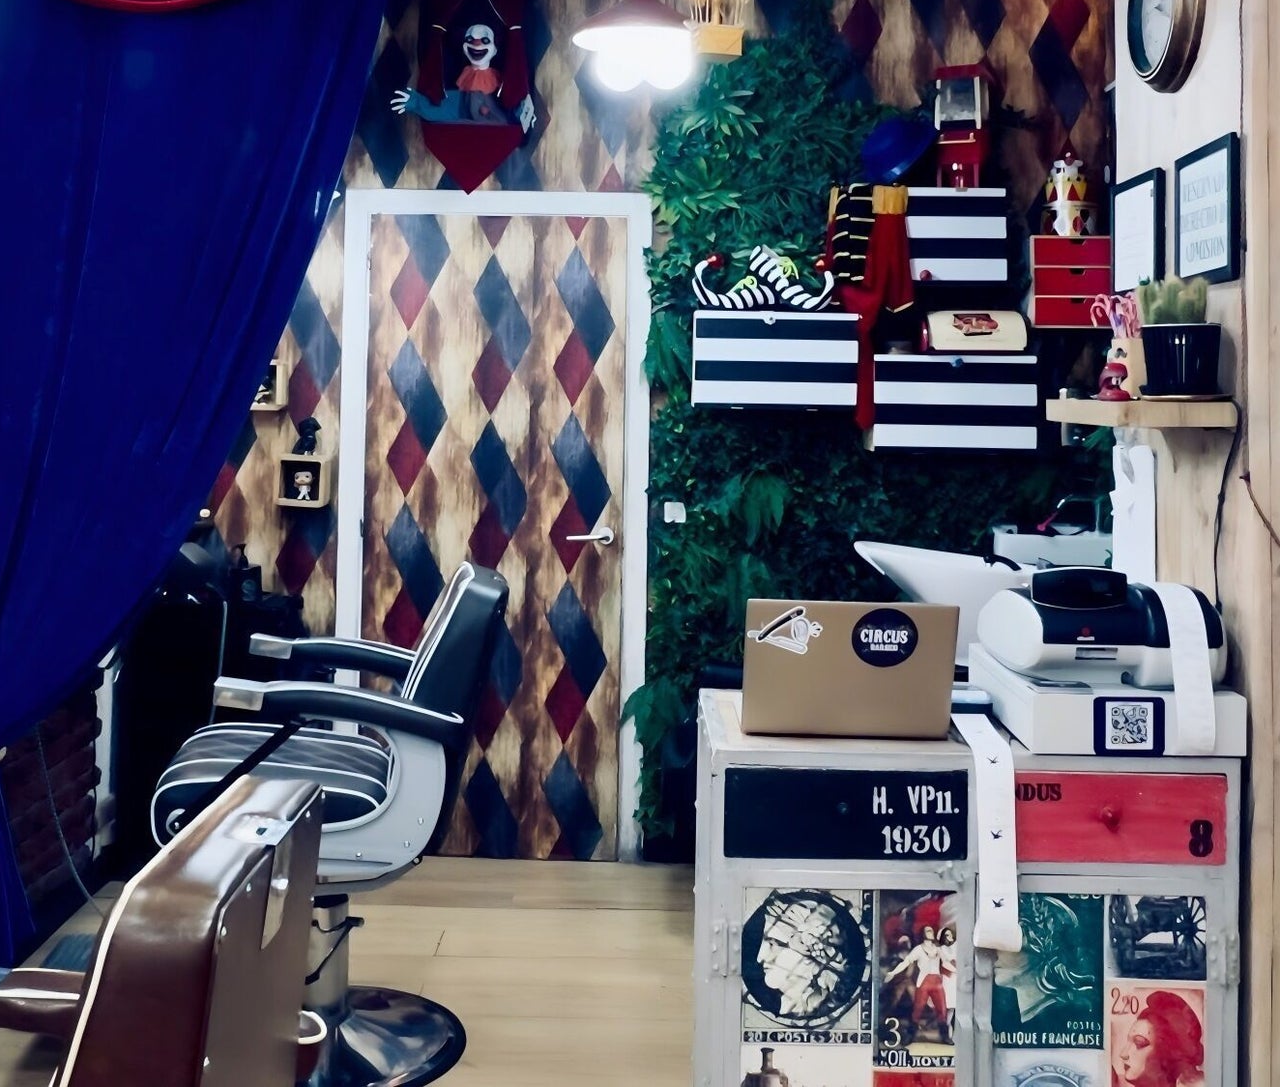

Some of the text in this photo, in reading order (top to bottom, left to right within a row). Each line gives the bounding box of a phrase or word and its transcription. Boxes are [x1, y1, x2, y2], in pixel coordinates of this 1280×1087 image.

[860, 628, 909, 644] CIRCUS
[873, 786, 894, 815] H.
[881, 825, 951, 854] 1930
[1189, 819, 1214, 858] 8
[884, 1017, 901, 1048] 3
